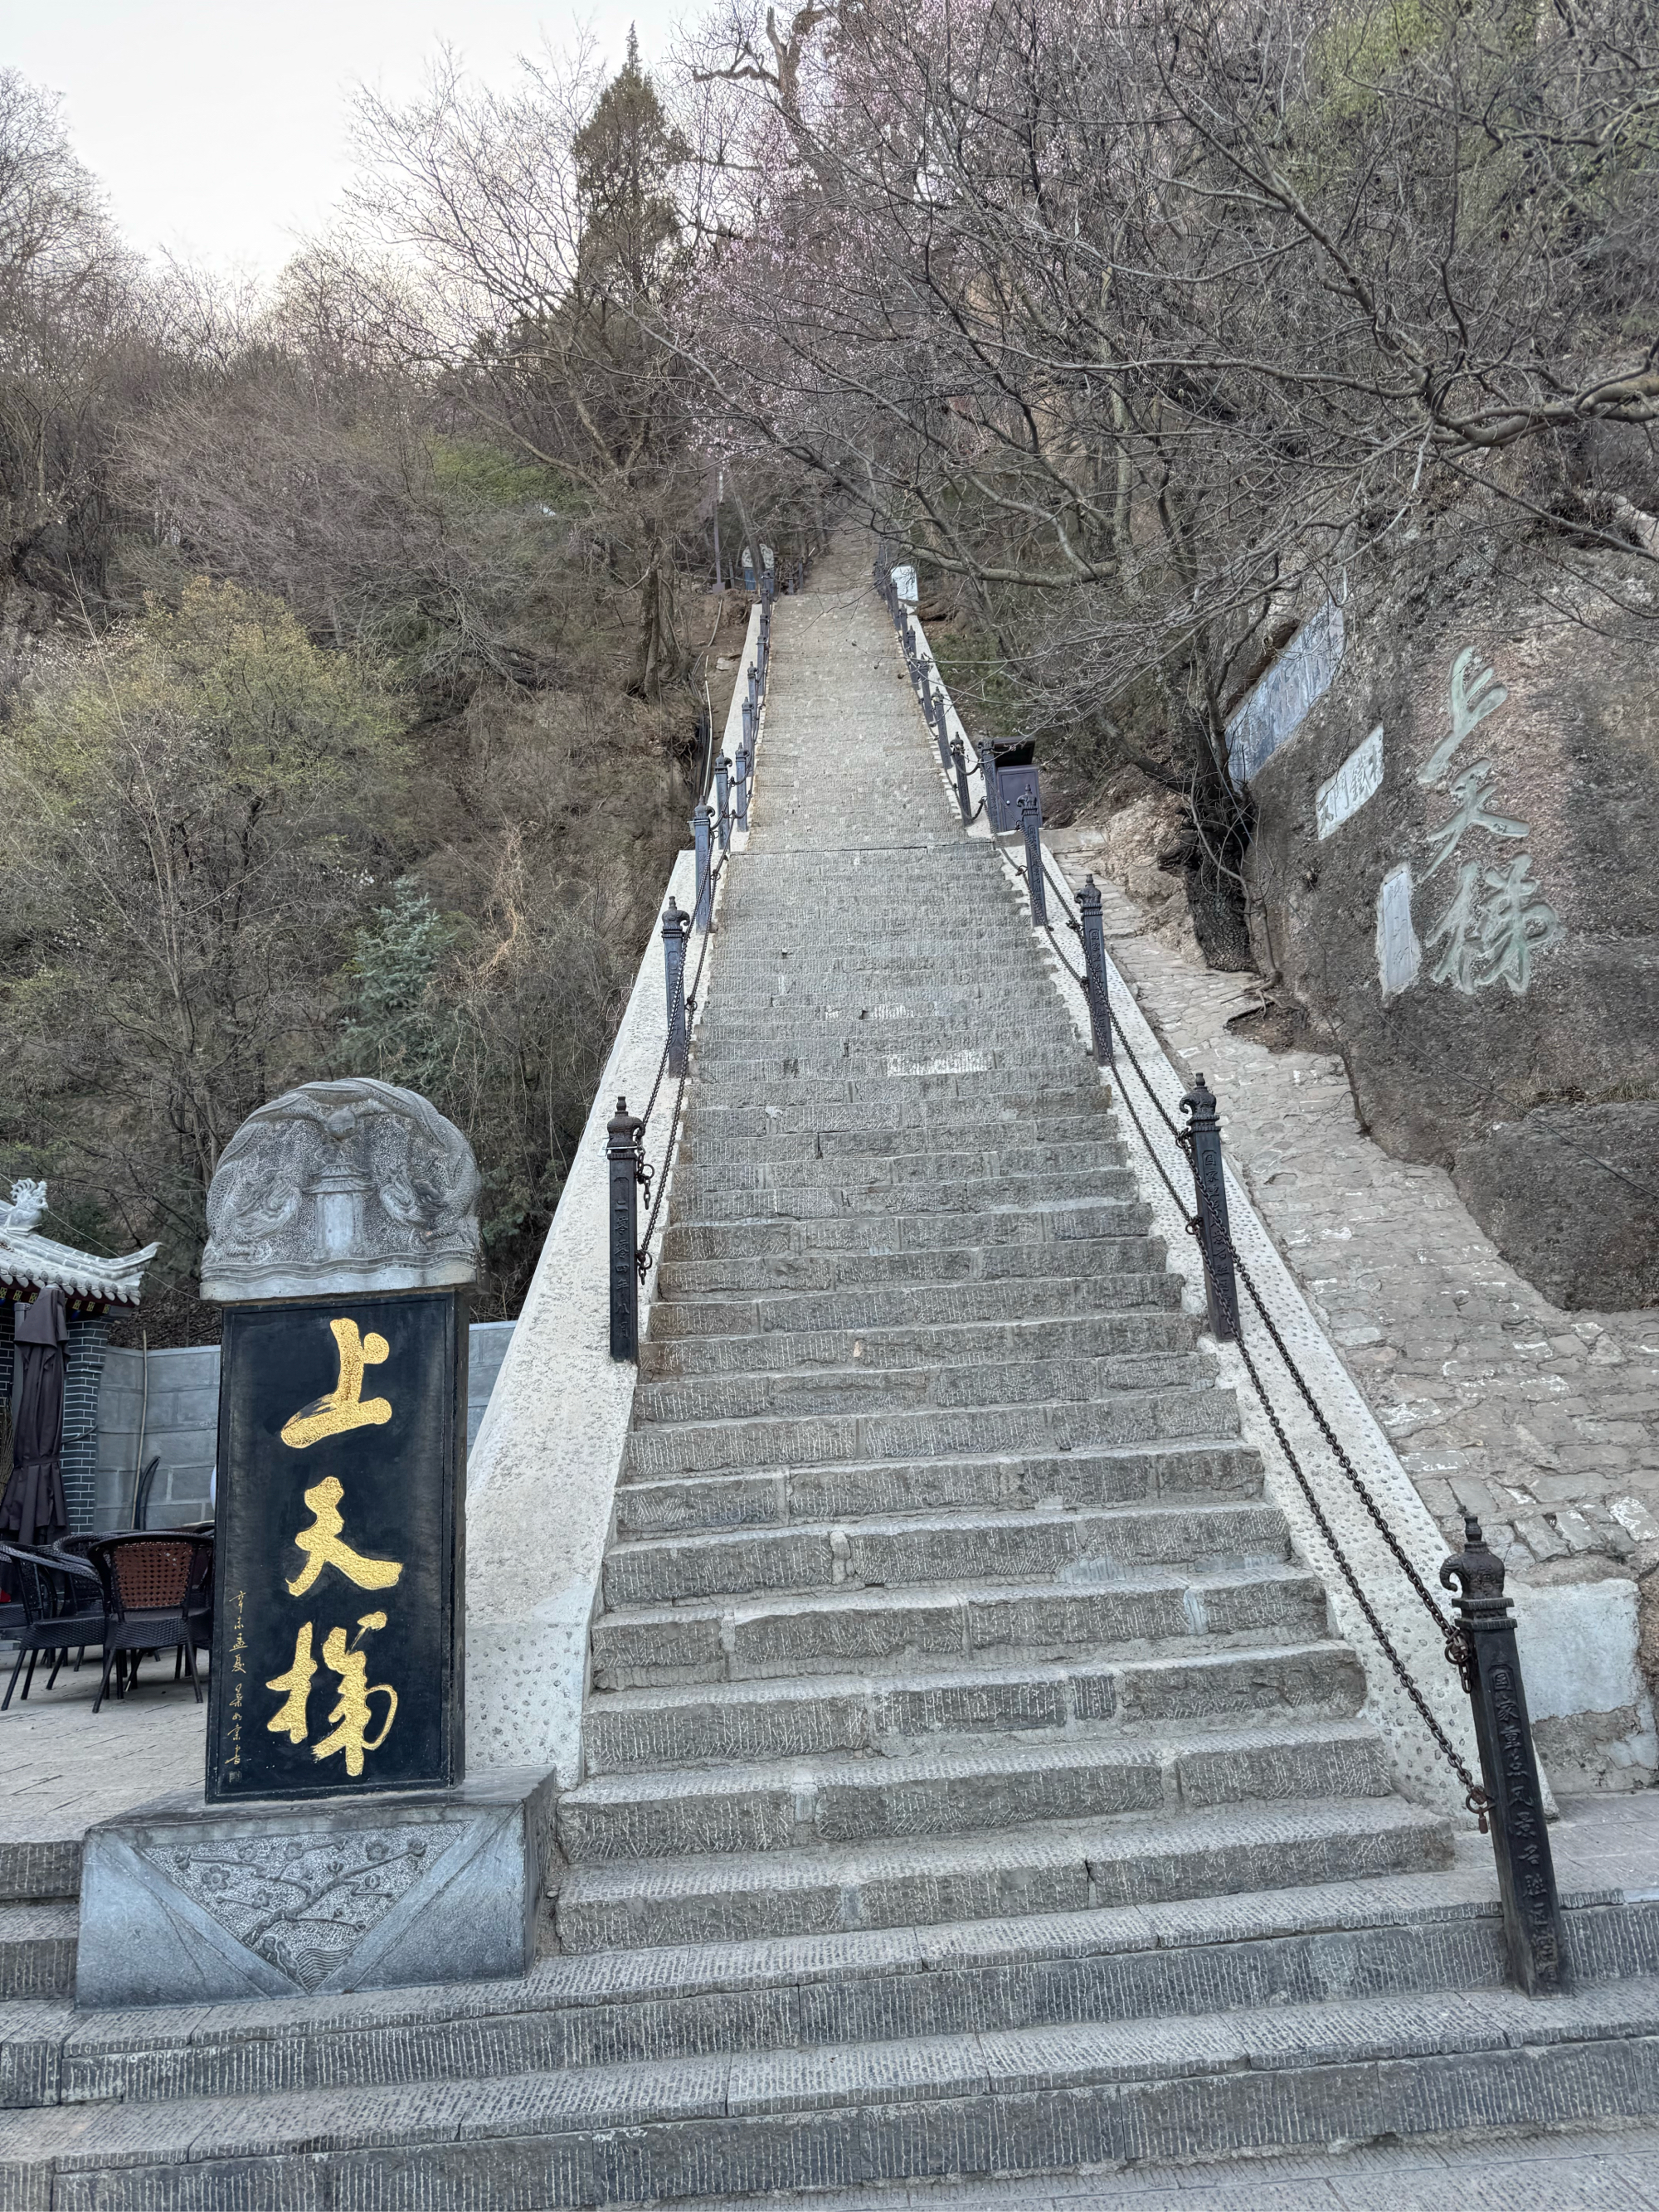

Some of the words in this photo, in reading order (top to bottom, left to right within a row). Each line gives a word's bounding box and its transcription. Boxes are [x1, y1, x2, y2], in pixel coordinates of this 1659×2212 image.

[1416, 646, 1559, 995] 上天梯
[266, 1317, 405, 1777] 上天梯
